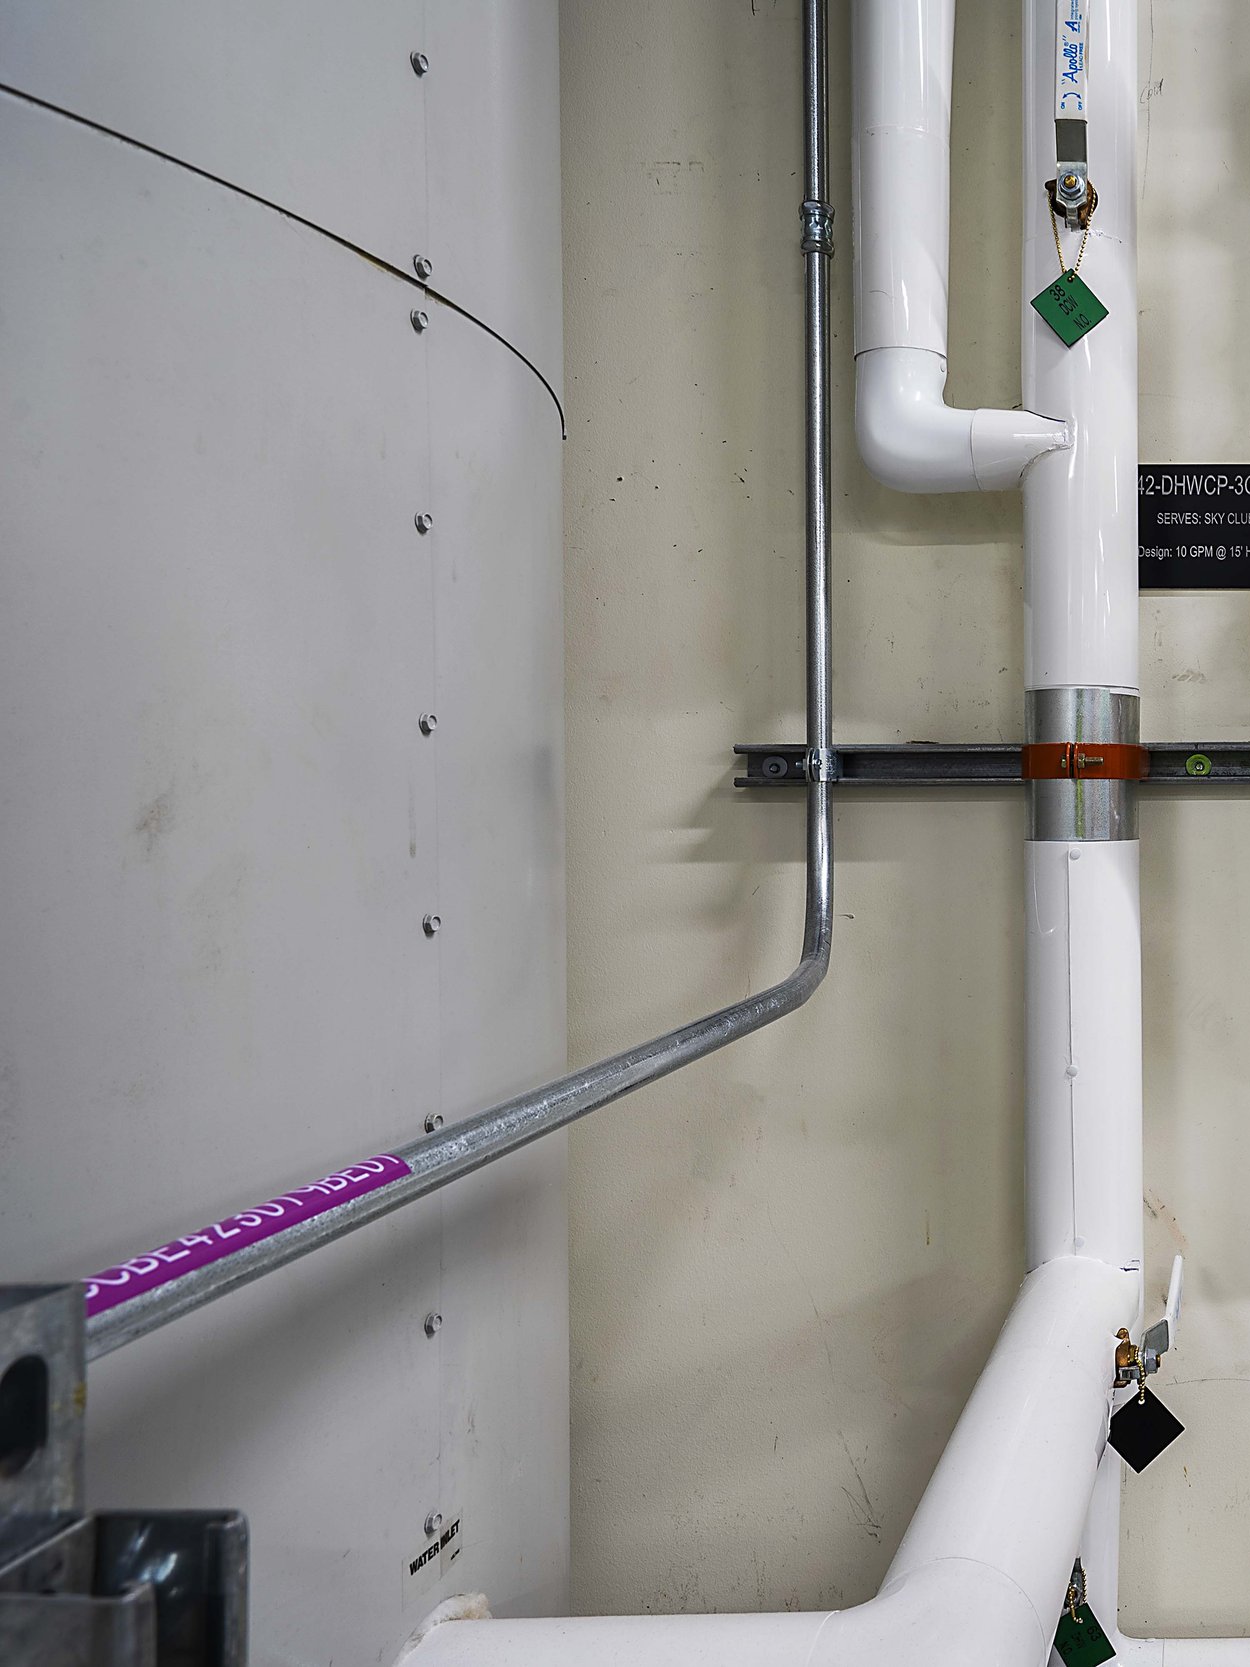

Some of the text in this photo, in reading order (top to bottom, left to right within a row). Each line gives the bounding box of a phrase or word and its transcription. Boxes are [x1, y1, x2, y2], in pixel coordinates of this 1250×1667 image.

[1049, 284, 1066, 302] 38
[1073, 313, 1092, 331] N.O.
[1156, 512, 1202, 525] SERVES:
[1204, 512, 1225, 525] SKY
[1138, 545, 1173, 560] Design:
[1175, 546, 1187, 557] 10
[1189, 545, 1213, 558] GPM
[1229, 545, 1243, 558] 15'
[409, 1518, 460, 1576] WATER INLET
